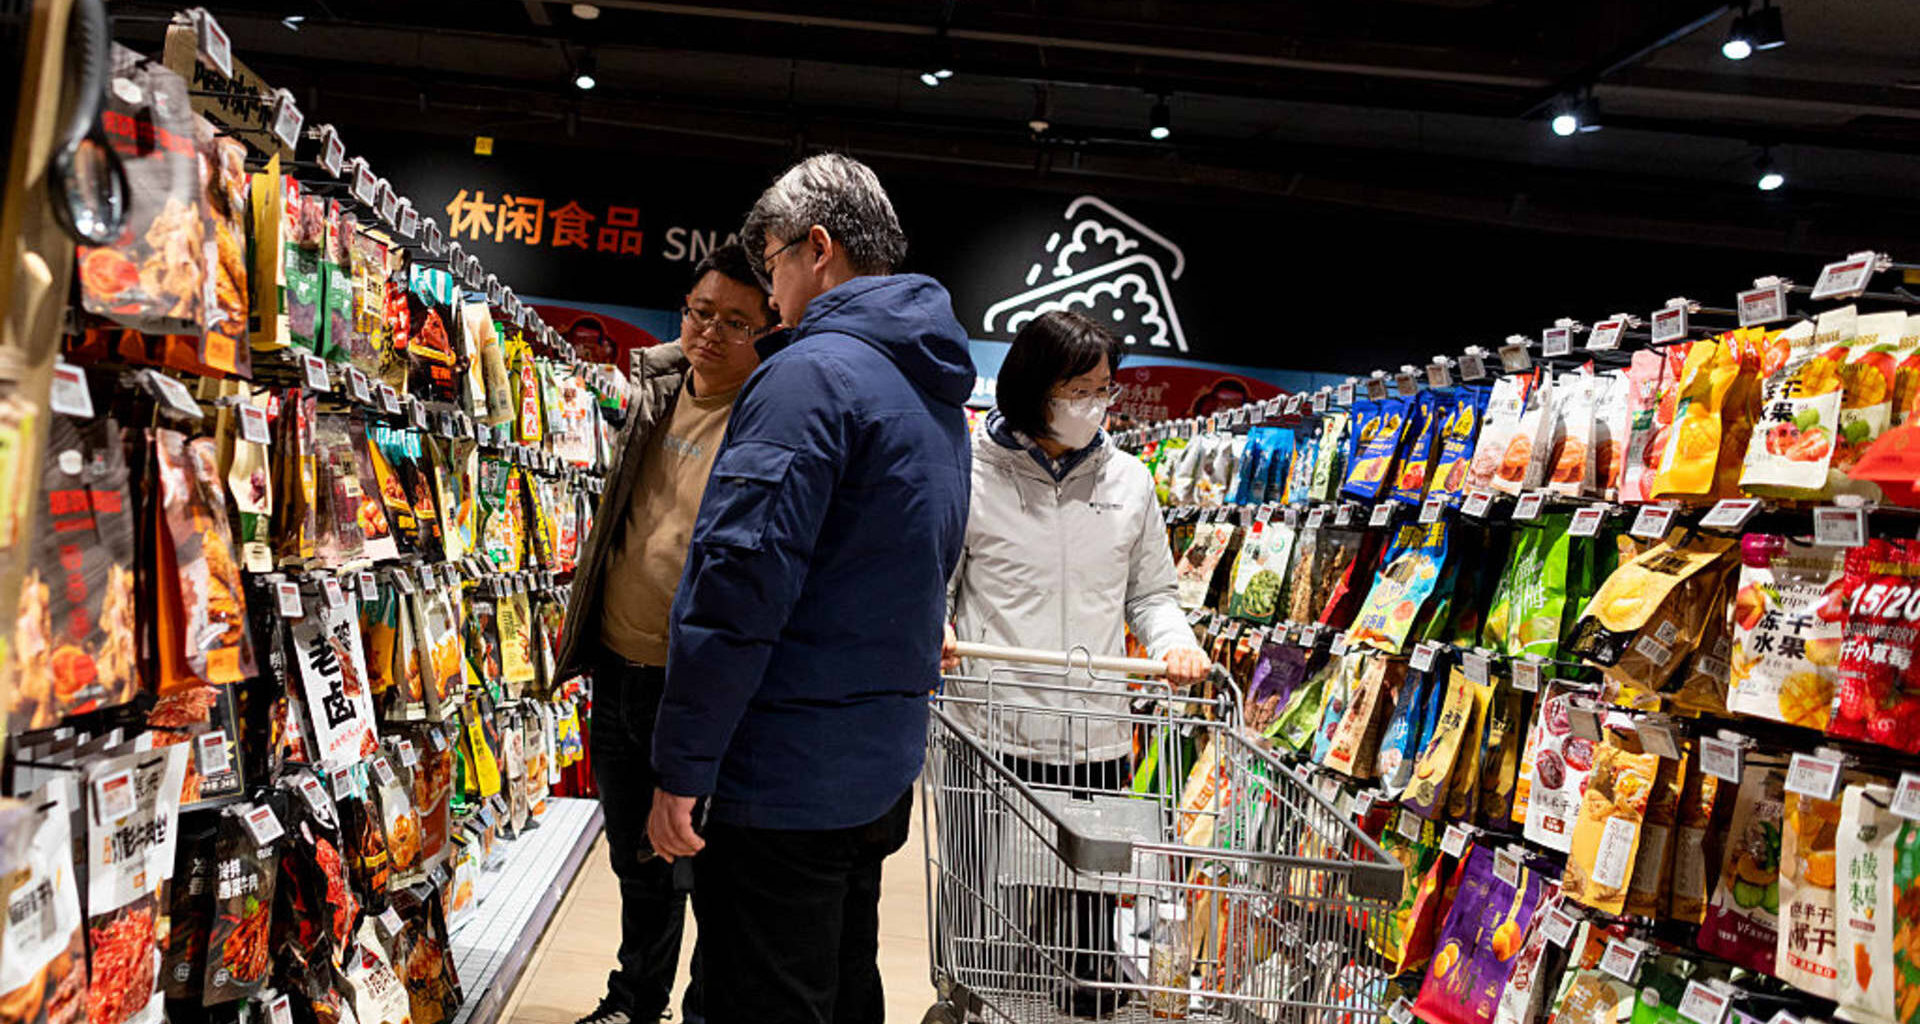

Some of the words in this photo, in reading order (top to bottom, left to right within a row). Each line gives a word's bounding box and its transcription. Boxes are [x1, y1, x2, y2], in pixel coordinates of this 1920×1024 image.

[445, 189, 644, 256] 休闲食品
[1759, 610, 1813, 634] 冻干
[1754, 632, 1806, 660] 水果
